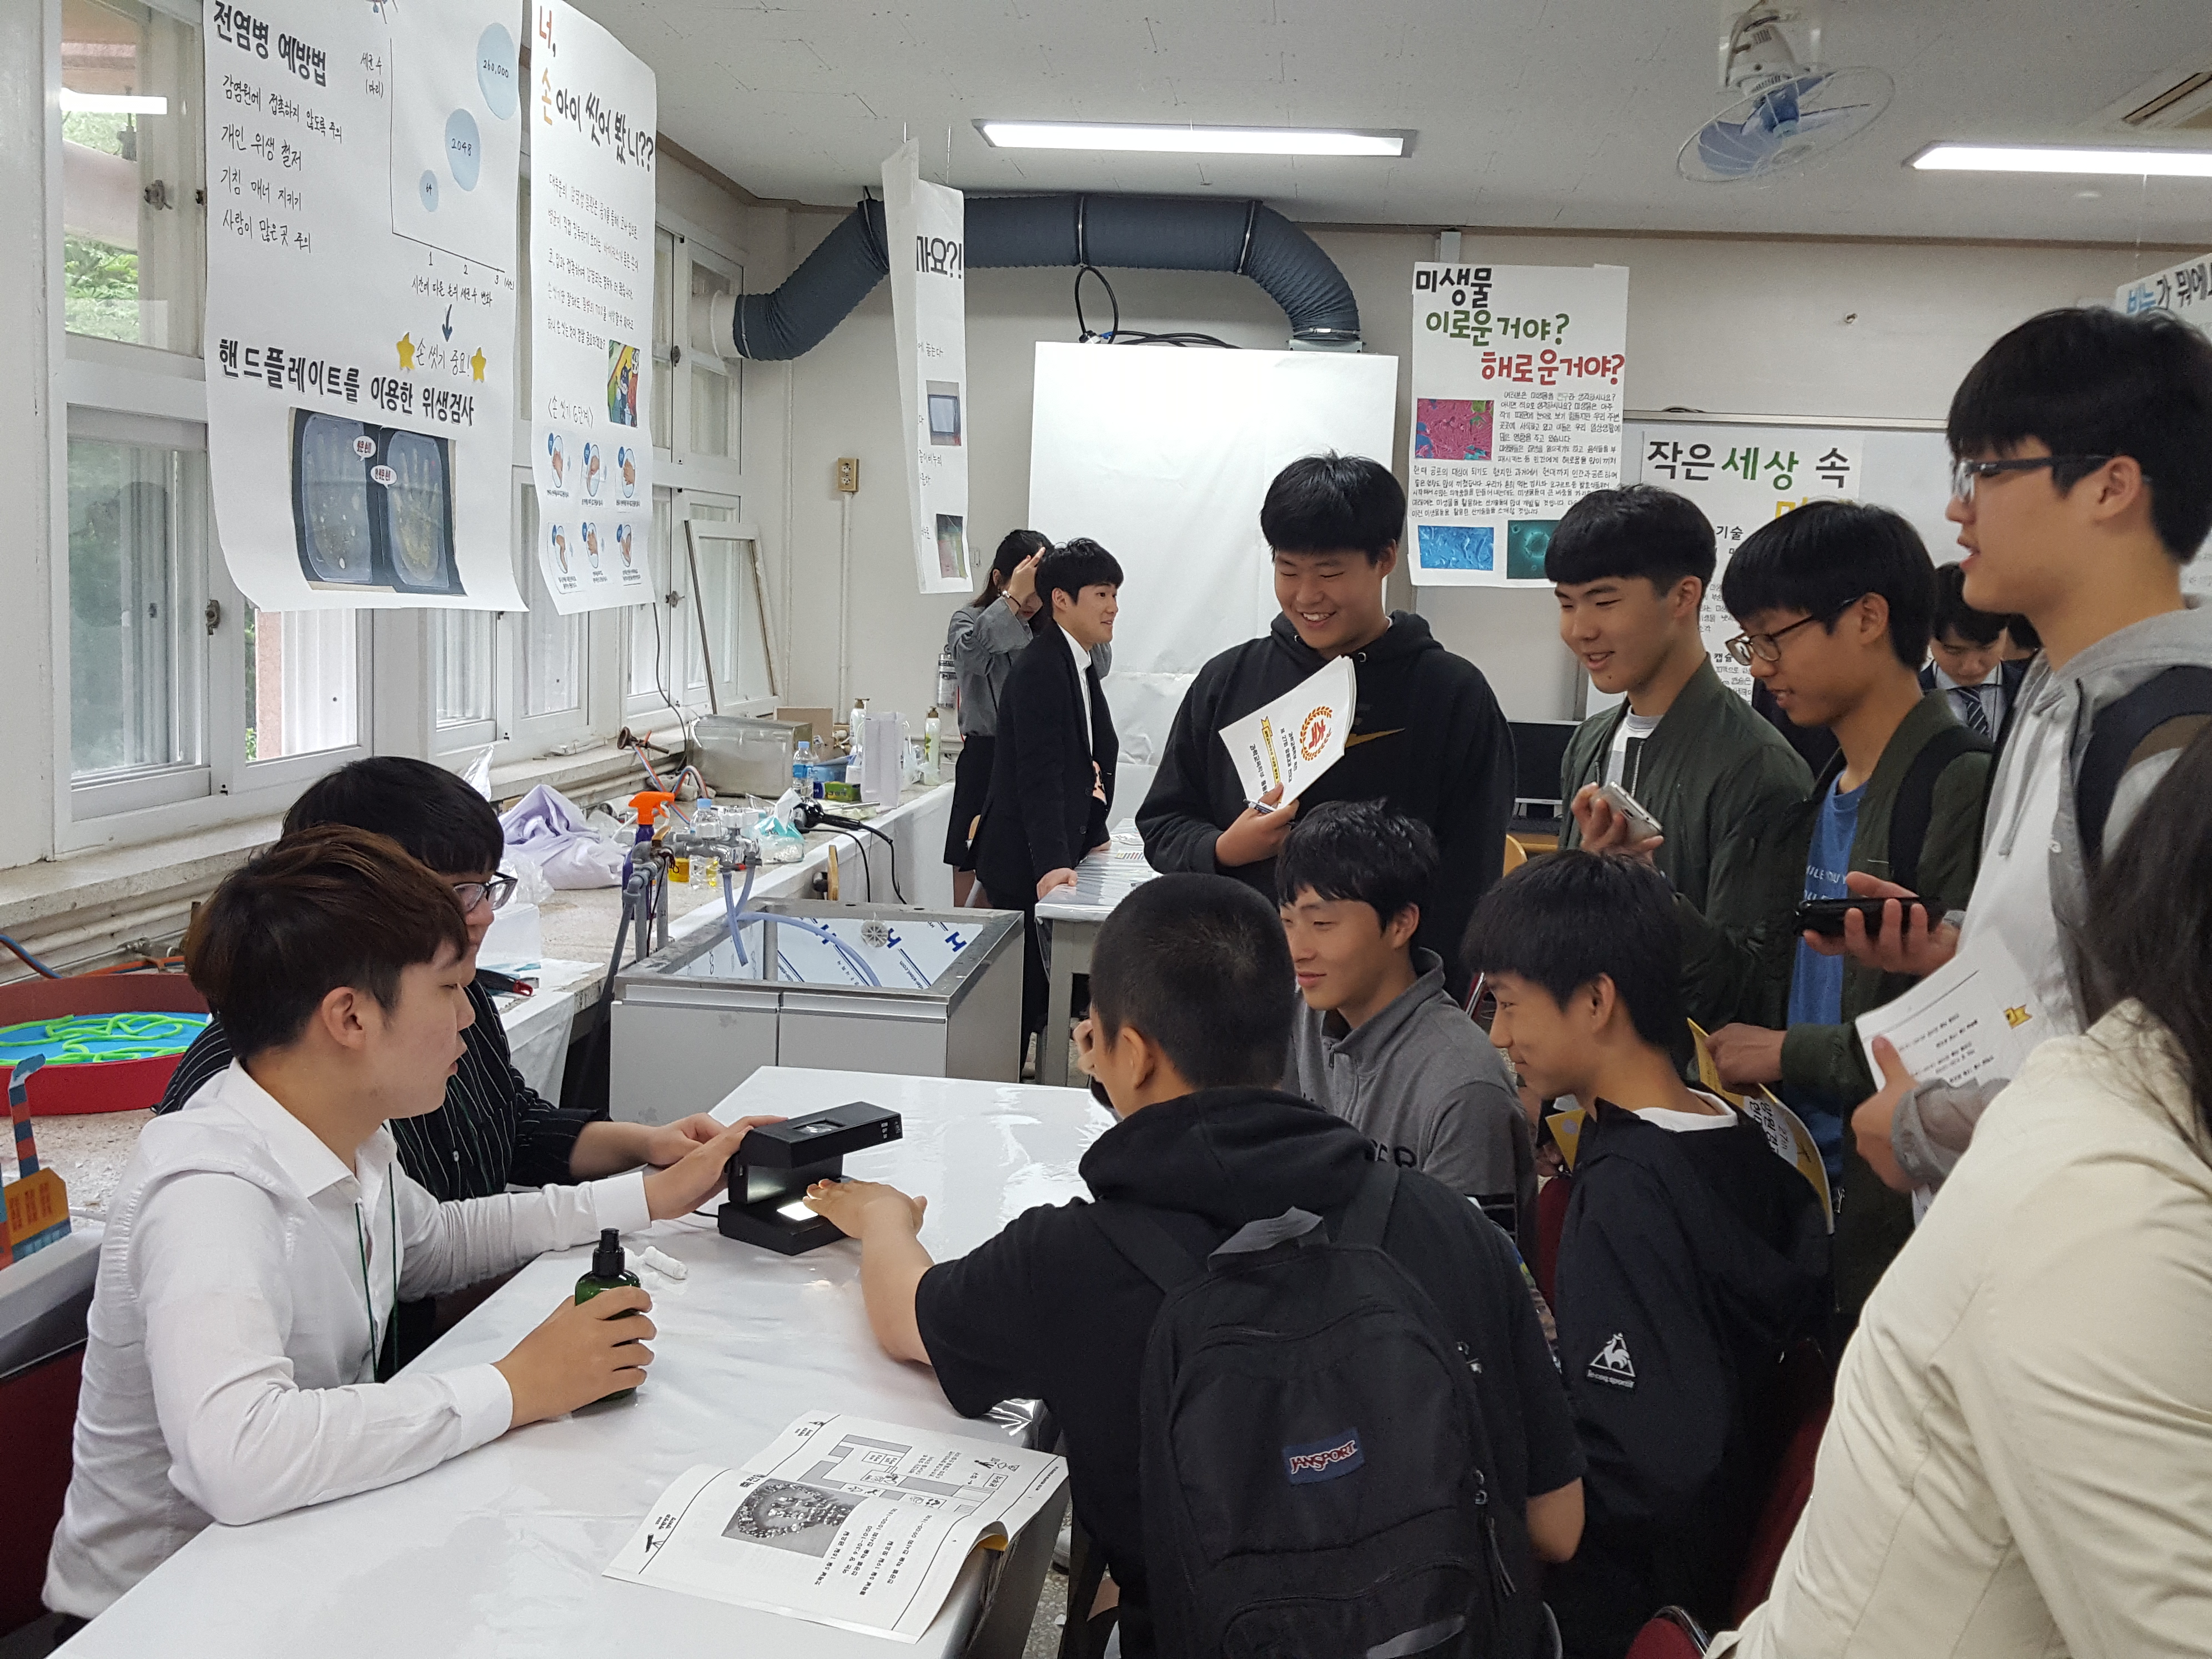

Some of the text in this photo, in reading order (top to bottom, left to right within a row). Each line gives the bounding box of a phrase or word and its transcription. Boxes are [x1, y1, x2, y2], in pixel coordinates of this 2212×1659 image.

[214, 1, 326, 86] 전염병 예방법
[539, 6, 556, 58] 너,
[482, 59, 510, 78] 260,000
[365, 80, 384, 99] (마리)
[223, 74, 342, 143] 감염원에 접촉하지 않도록 주의
[585, 92, 611, 147] 씻어
[221, 124, 301, 171] 개인 위생 철저
[451, 138, 472, 157] 2048
[220, 167, 301, 210] 기침 매너 지키기
[425, 183, 433, 195] 64
[549, 173, 566, 199] 대부분의
[222, 209, 252, 239] 사람이
[294, 232, 311, 253] 주의
[563, 215, 571, 237] 직접
[428, 251, 433, 266] 1
[462, 265, 469, 275] 2
[494, 274, 499, 284] 3
[411, 273, 429, 296] 시간에
[432, 277, 445, 297] 따른
[447, 281, 458, 301] 손의
[481, 289, 492, 308] 변화
[1416, 268, 1492, 308] 미생물
[417, 338, 470, 378] 손 씻기 중요!
[926, 341, 943, 358] 놓는다
[219, 339, 474, 426] 핸드플레이트를 이용한 위생검사
[1607, 413, 1620, 421] 주변
[1647, 441, 1850, 490] 작은 세상 속
[1716, 525, 1744, 540] 기술
[1289, 1440, 1358, 1474] JANSPORT
